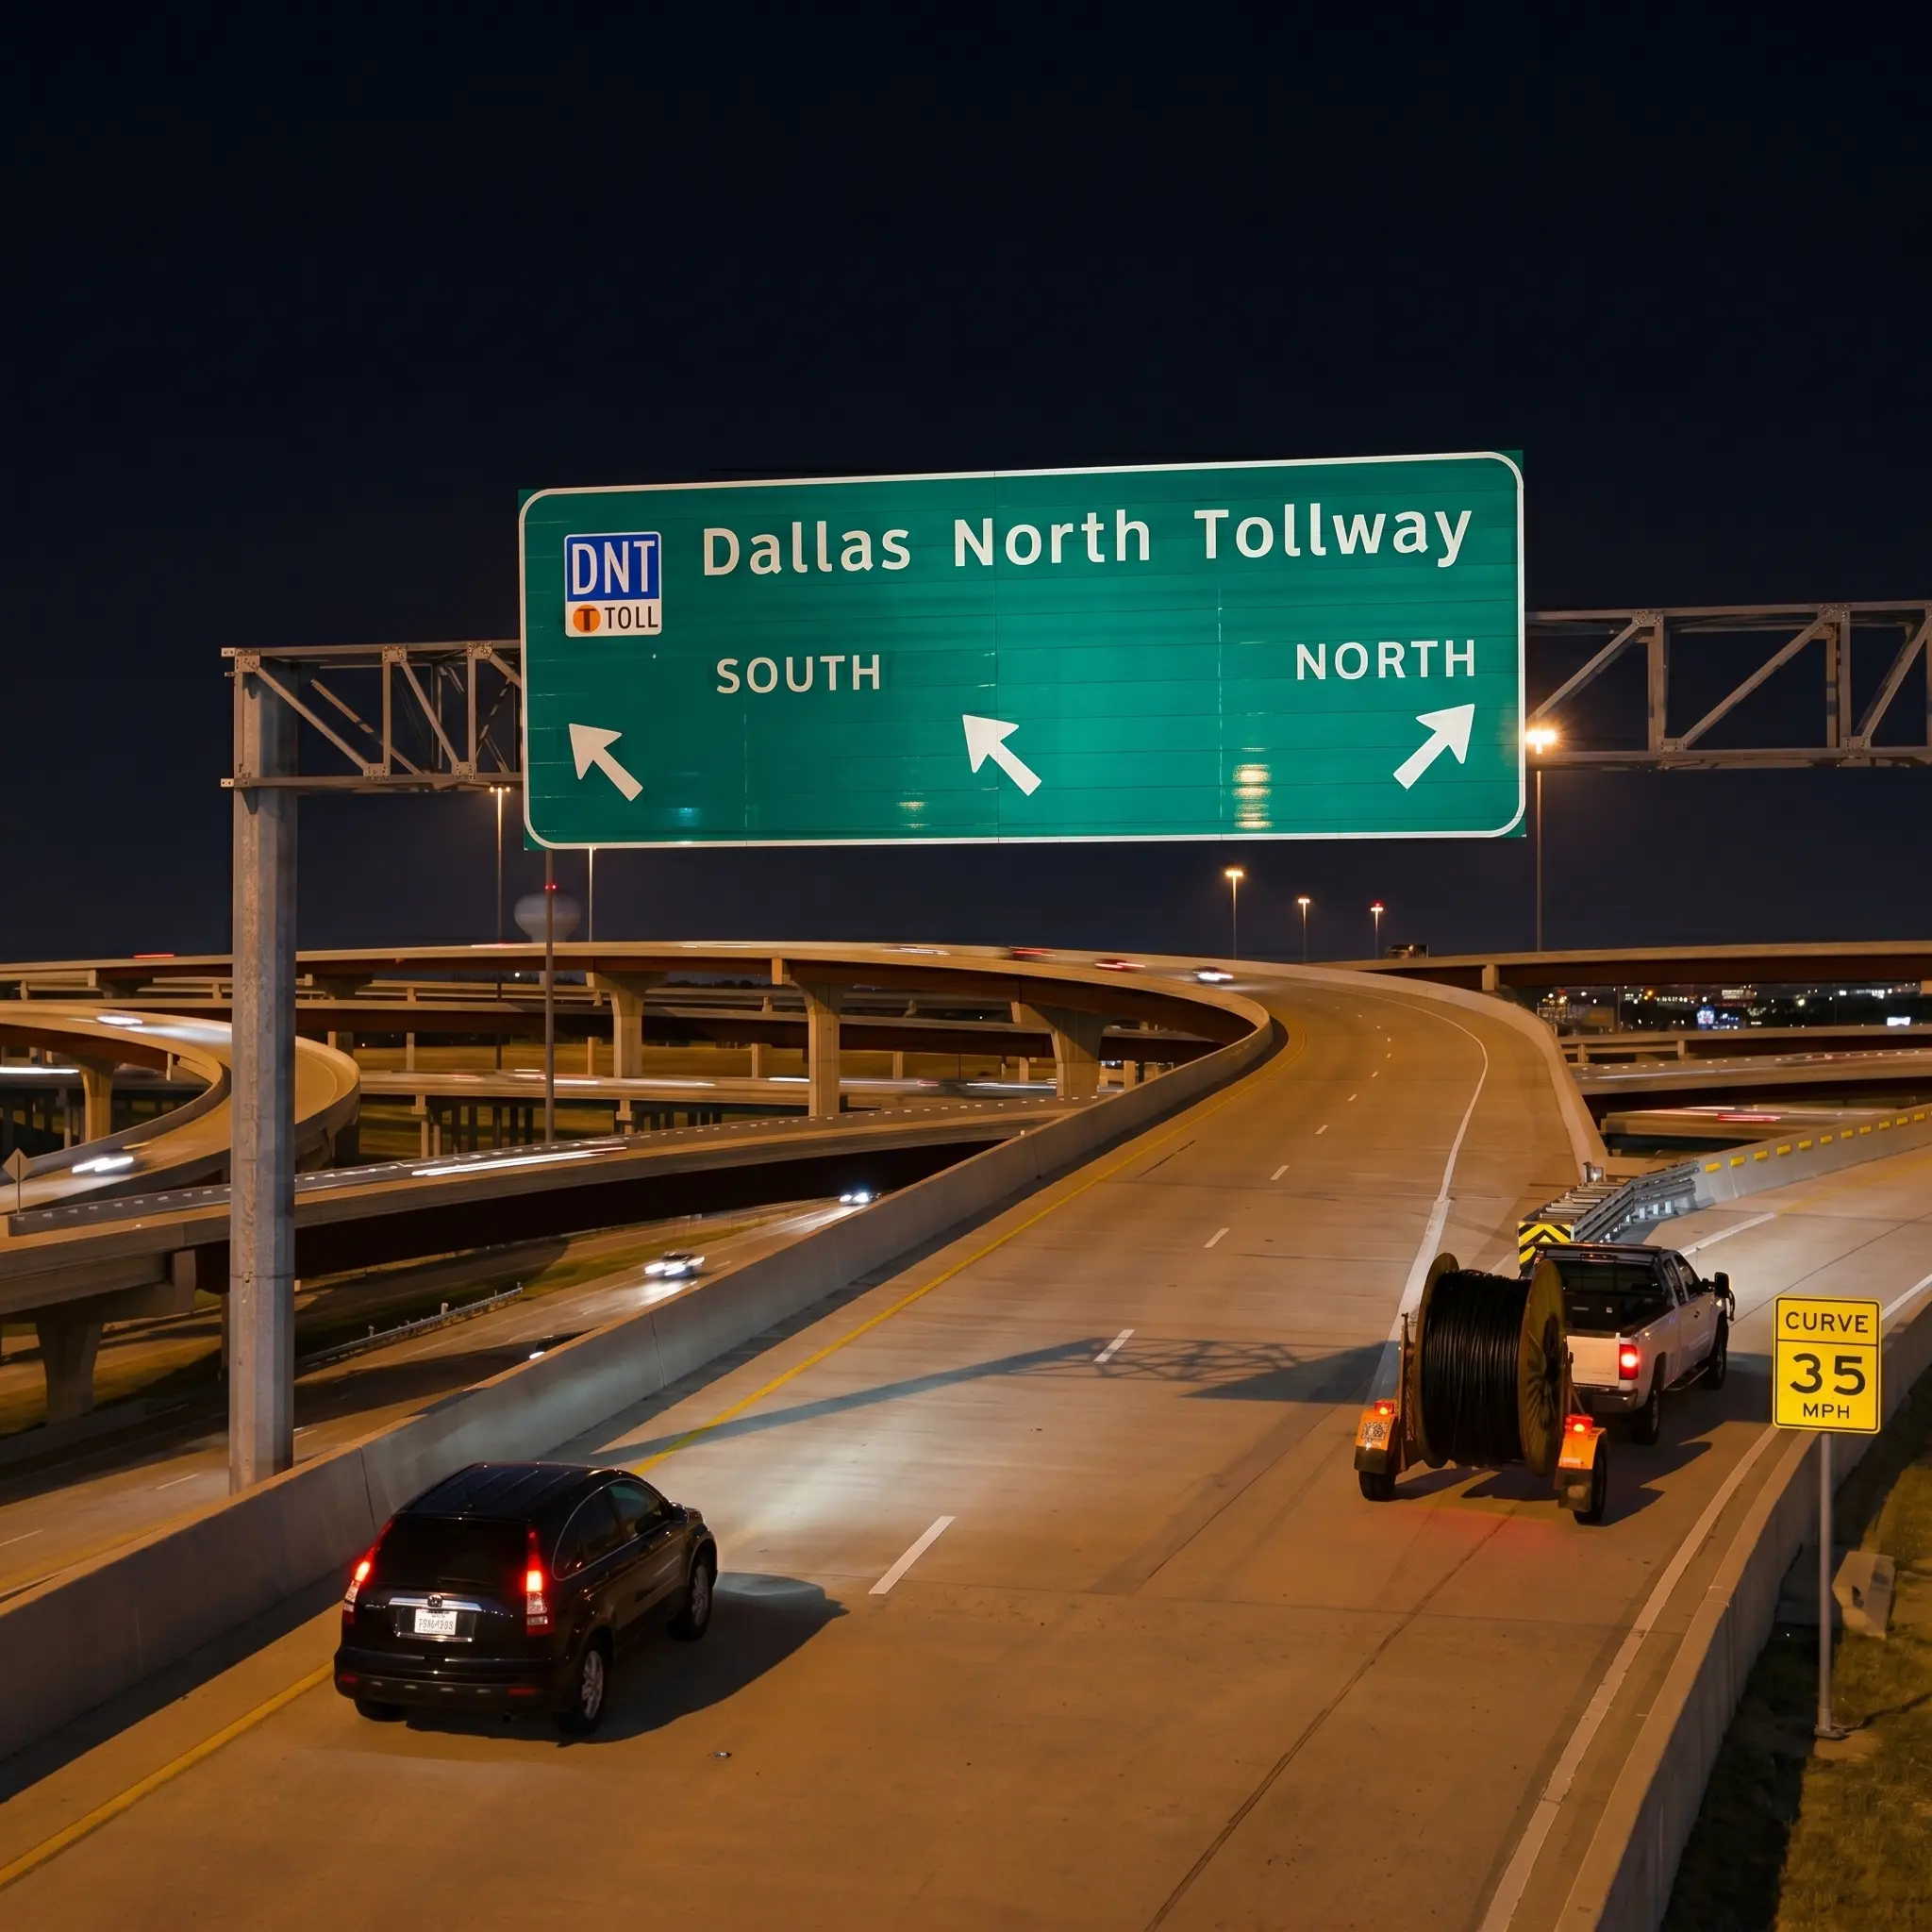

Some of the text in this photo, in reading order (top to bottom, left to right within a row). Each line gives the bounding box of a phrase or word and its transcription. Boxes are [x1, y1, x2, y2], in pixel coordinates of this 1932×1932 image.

[704, 502, 1473, 576] Dallas North Tollway
[571, 539, 656, 595] DNT
[604, 606, 659, 629] TOLL
[716, 654, 881, 694] SOUTH
[1296, 639, 1475, 680] NORTH
[1785, 1311, 1869, 1334] CURVE
[1790, 1353, 1866, 1396] 35
[1803, 1403, 1850, 1419] MPH
